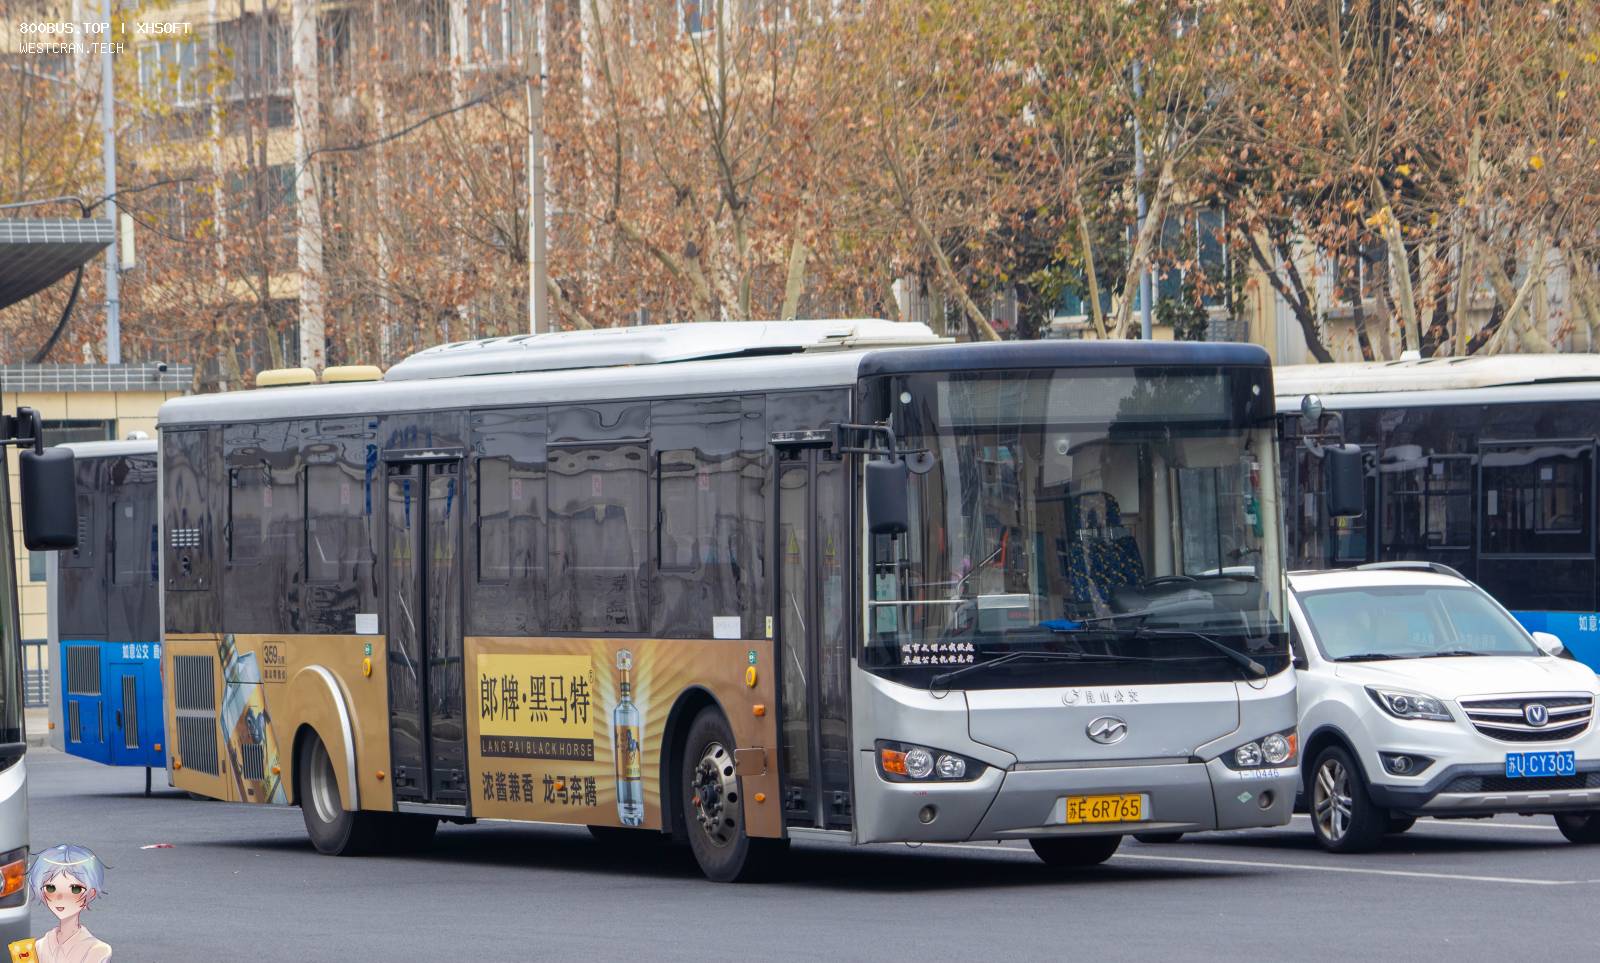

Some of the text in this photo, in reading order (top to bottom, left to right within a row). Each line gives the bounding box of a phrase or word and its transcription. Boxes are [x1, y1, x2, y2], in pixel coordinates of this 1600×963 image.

[1579, 614, 1600, 631] 如意
[1085, 688, 1139, 704] 昆山公交
[559, 742, 593, 757] HORSE
